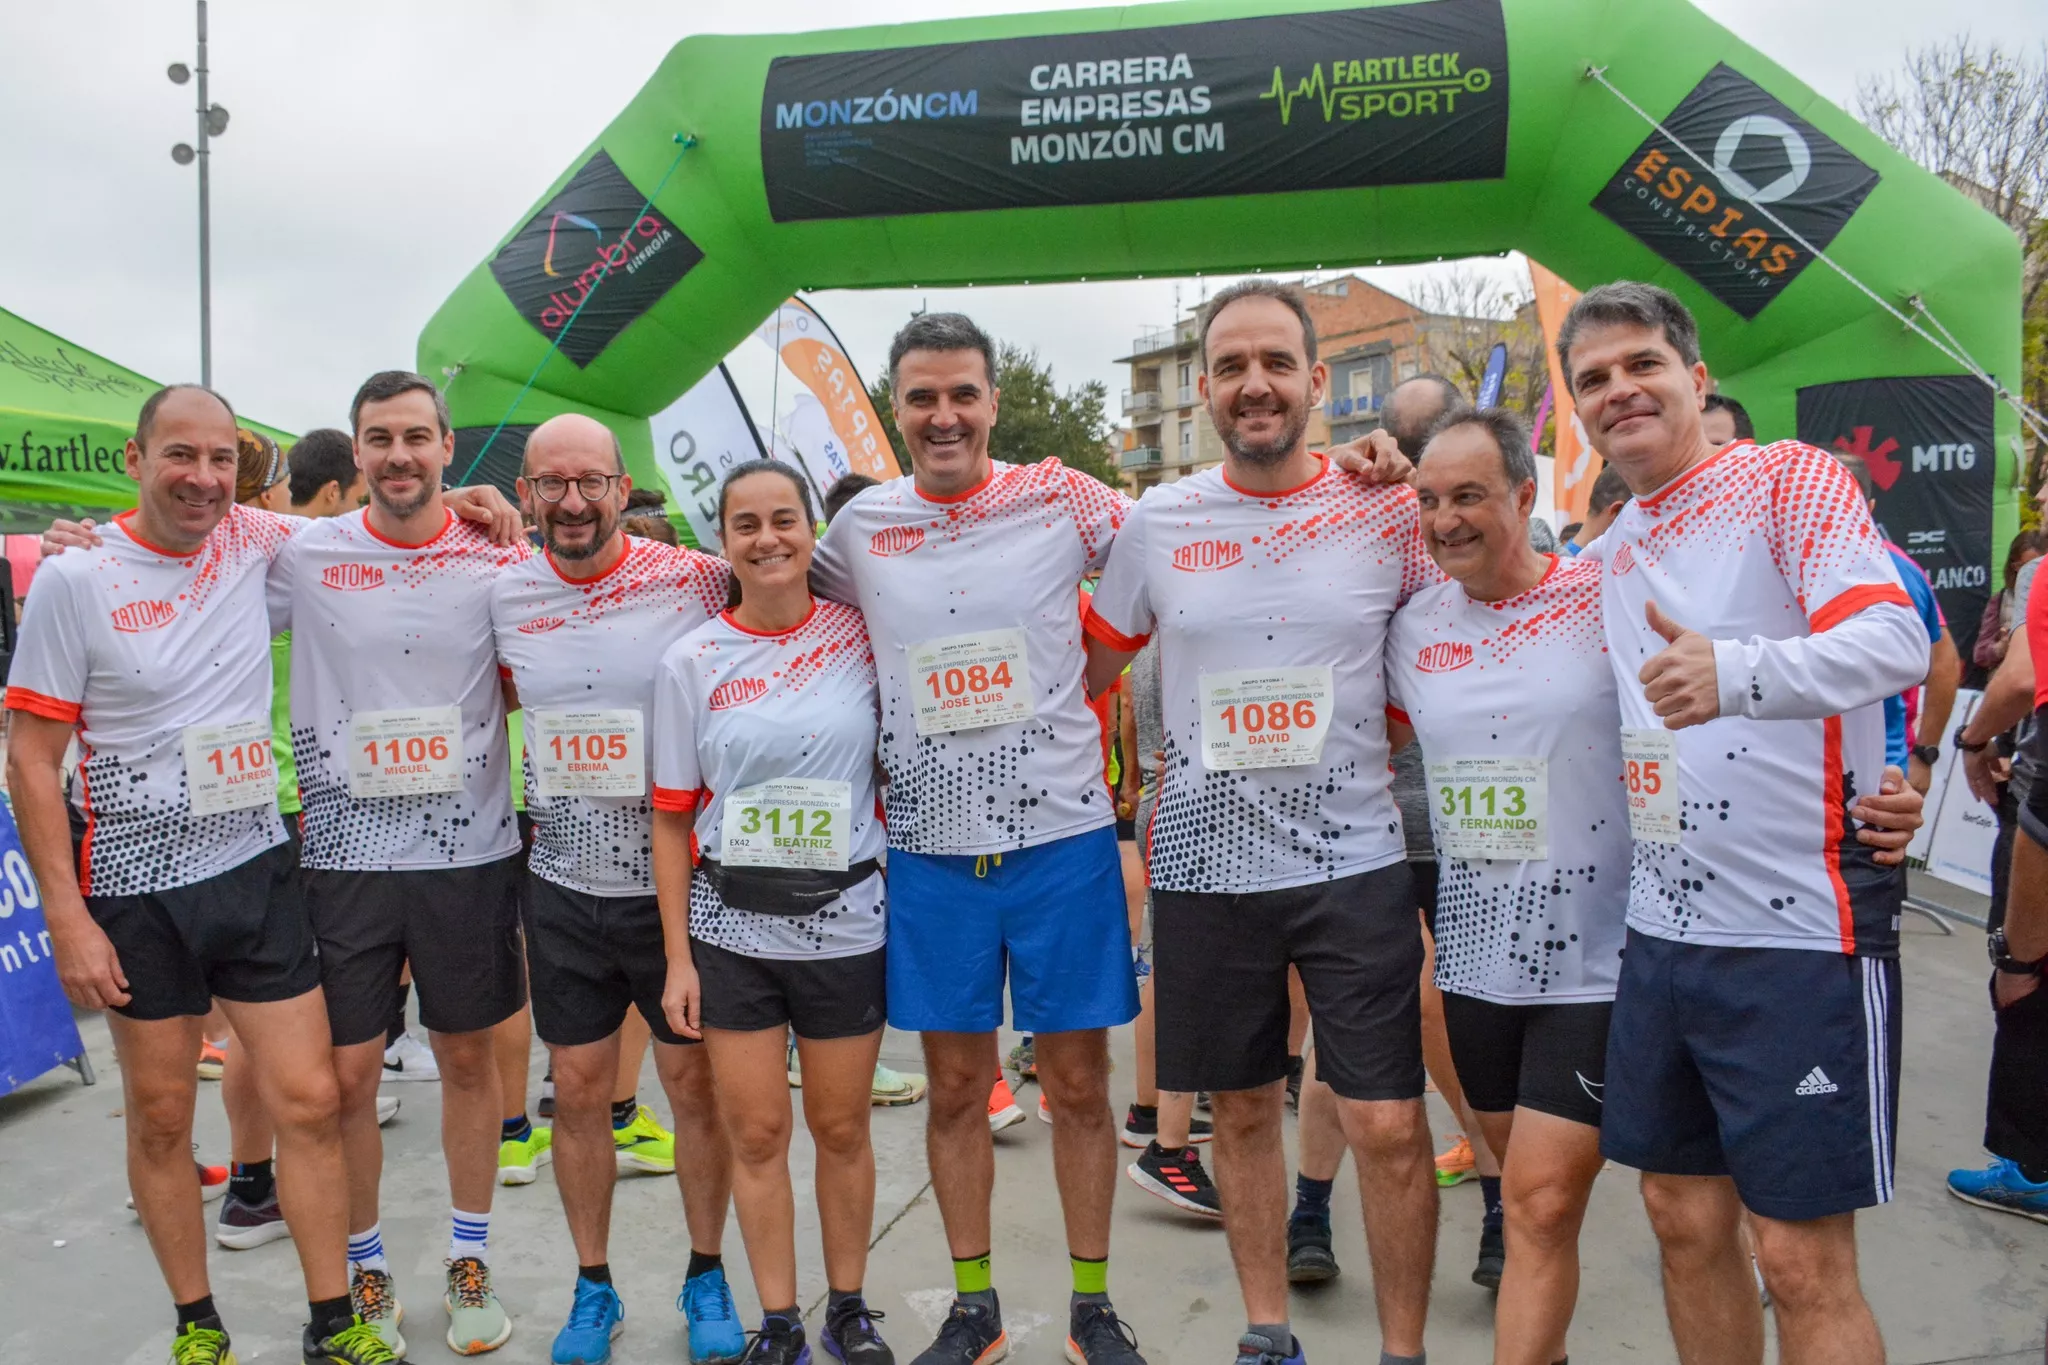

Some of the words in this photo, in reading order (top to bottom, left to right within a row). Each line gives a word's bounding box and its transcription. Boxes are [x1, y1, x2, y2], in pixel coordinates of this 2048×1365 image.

[1030, 53, 1194, 92] CARRERA
[1333, 52, 1460, 84] FARTLECK
[776, 88, 978, 130] MONZÓNCM
[1021, 86, 1212, 126] EMPRESAS
[1340, 88, 1462, 121] SPORT
[1010, 121, 1163, 165] MONZÓN
[1172, 122, 1225, 154] CM
[1634, 148, 1797, 275] ESPIAS
[1623, 177, 1771, 288] CONSTRUCTORA
[626, 229, 673, 275] ENERGÍA
[541, 215, 662, 328] alumbra
[0, 431, 125, 475] .fartlec
[1912, 443, 1976, 473] MTG
[871, 525, 925, 552] TATOMA
[1173, 540, 1242, 567] TATOMA
[323, 563, 383, 587] TATOMA
[1926, 565, 1985, 590] LANCO
[111, 600, 175, 628] TATOMA
[918, 663, 943, 674] CARRERA
[943, 658, 978, 669] EMPRESAS
[979, 653, 1007, 663] MONZÓN
[1008, 652, 1019, 660] CM
[1418, 641, 1473, 668] TATOMA
[926, 661, 1013, 699] 1084
[940, 695, 970, 710] JOSÉ
[974, 692, 1004, 705] LUIS
[1211, 697, 1242, 707] CARRERA
[1242, 694, 1280, 703] EMPRESAS
[1281, 691, 1312, 701] MONZÓN
[1313, 691, 1325, 699] CM
[1220, 700, 1317, 734] 1086
[364, 736, 449, 766] 1106
[550, 734, 628, 761] 1105
[1211, 741, 1231, 749] EM34
[1248, 733, 1290, 745] DAVID
[226, 768, 272, 786] ALFREDO
[384, 763, 432, 775] MIGUEL
[567, 762, 609, 773] EBRIMA
[1625, 760, 1662, 795] 85
[763, 798, 798, 806] EMPRESAS
[799, 798, 829, 808] MONZÓN
[830, 801, 841, 809] CM
[1439, 785, 1527, 817] 3113
[1629, 796, 1646, 808] LOS
[740, 806, 832, 837] 3112
[1460, 818, 1538, 830] FERNANDO
[729, 838, 750, 847] EX42
[773, 837, 833, 849] BEATRIZ
[1795, 1083, 1838, 1095] adidas
